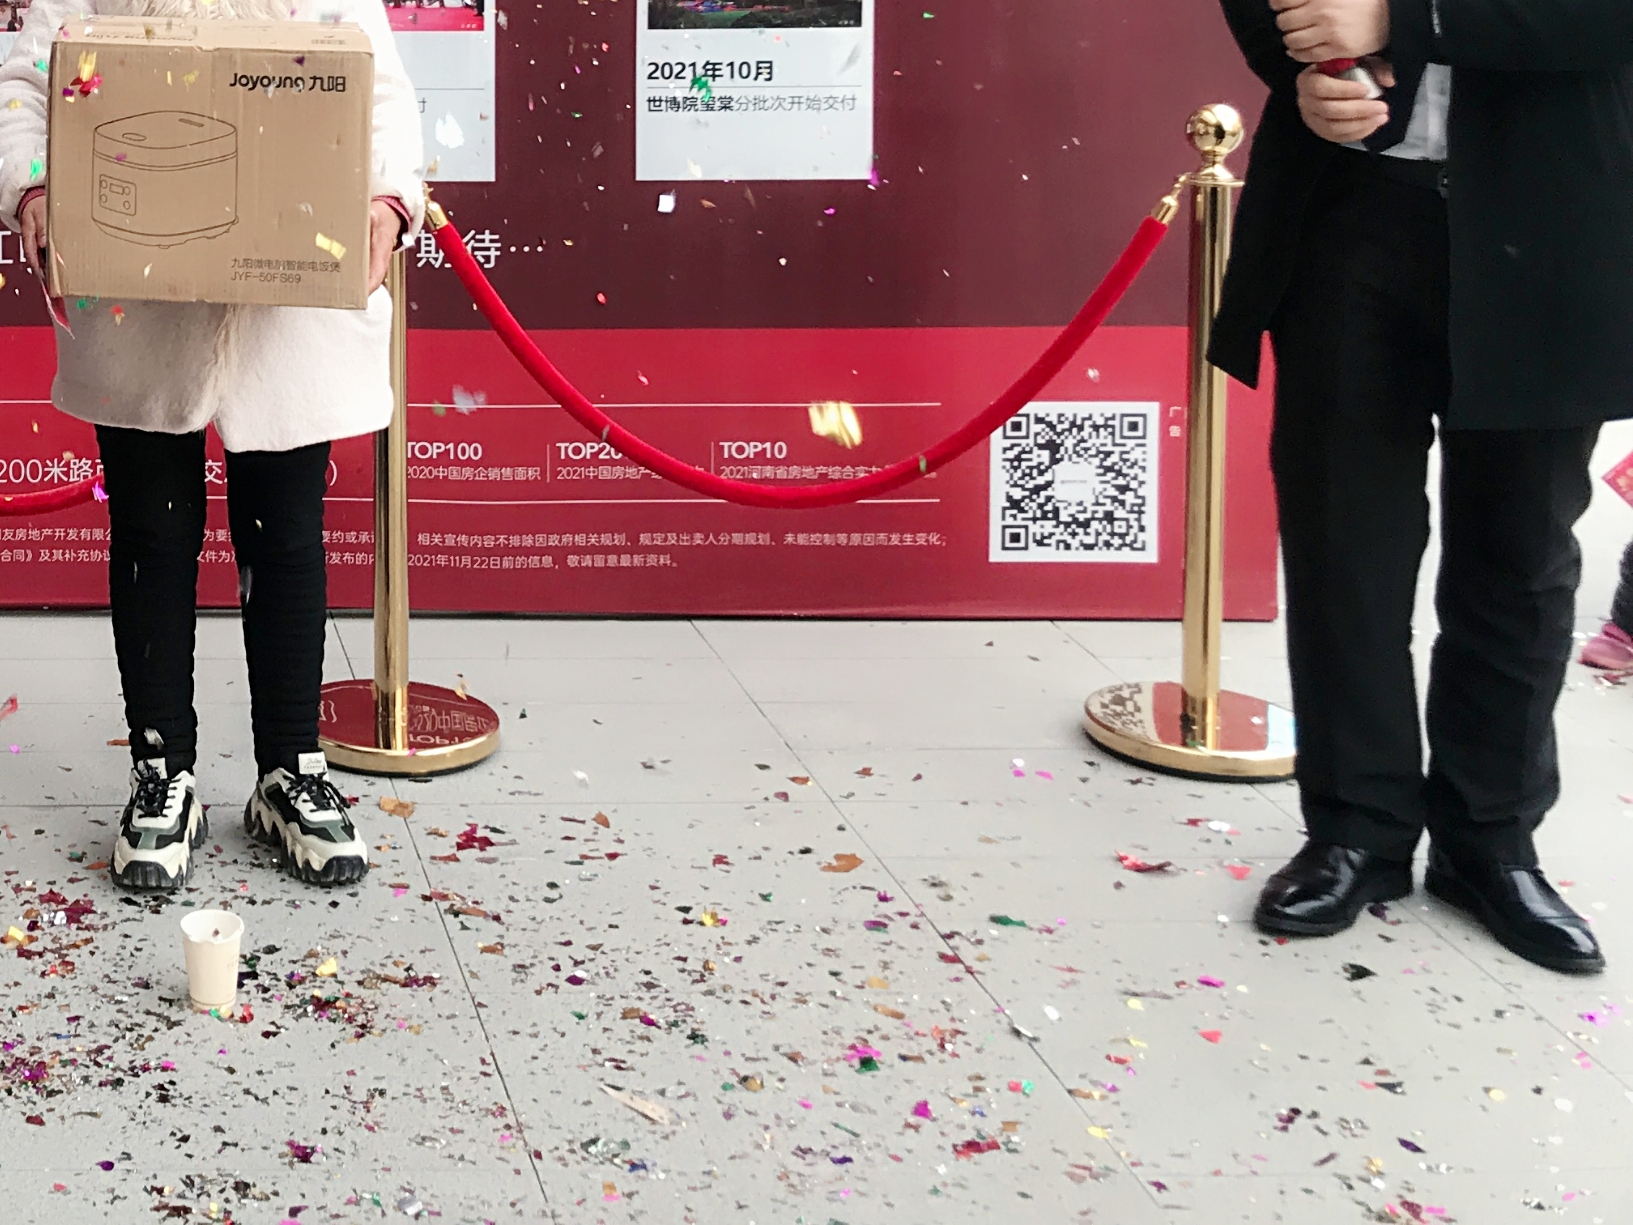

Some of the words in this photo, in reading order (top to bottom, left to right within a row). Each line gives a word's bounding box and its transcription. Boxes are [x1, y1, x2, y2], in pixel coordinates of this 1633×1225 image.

[646, 60, 774, 82] 2021年10月
[229, 72, 306, 93] Joyoung
[309, 74, 347, 93] 九阳
[230, 271, 302, 284] JYF-50FS69
[407, 441, 483, 460] TOP100
[719, 441, 788, 459] TOP10
[325, 551, 374, 565] 发布的
